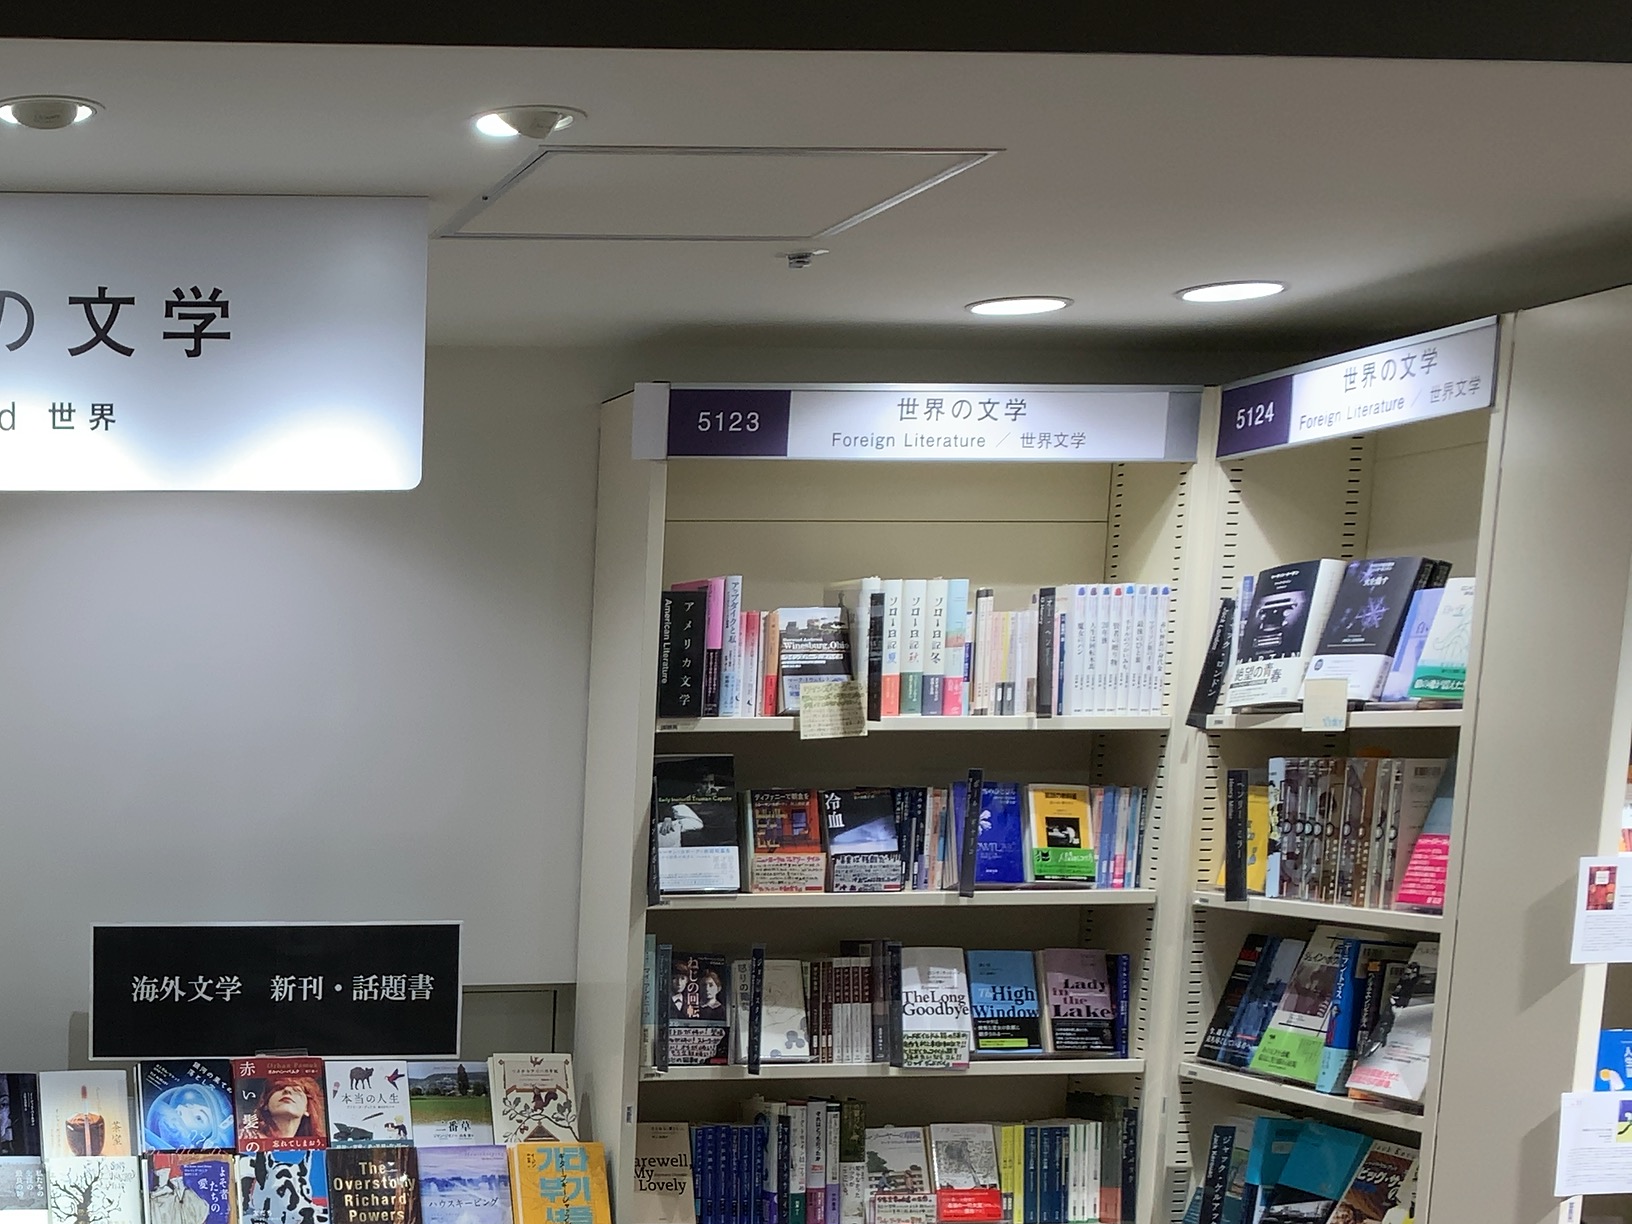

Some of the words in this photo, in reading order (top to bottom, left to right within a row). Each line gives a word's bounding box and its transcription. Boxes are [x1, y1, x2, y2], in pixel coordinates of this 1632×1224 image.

[1343, 348, 1440, 392] 世界の文学
[896, 397, 1029, 422] 世界の文学
[1299, 407, 1343, 430] Foreign
[1347, 395, 1406, 420] Literature
[1430, 375, 1482, 404] 世界文学
[48, 402, 118, 432] 世界
[697, 411, 760, 432] 5123
[1236, 402, 1276, 430] 5124
[831, 431, 897, 450] Foreign
[904, 431, 986, 447] Literature
[1020, 432, 1087, 449] 世界文学
[663, 598, 673, 641] American
[727, 581, 740, 644] アップダイクと私
[661, 642, 672, 685] Literature
[679, 601, 695, 707] アメリカ文学
[930, 651, 942, 665] 冬
[1233, 661, 1283, 684] 絶望の青春
[824, 792, 846, 829] 冷血
[131, 974, 243, 1001] 海外文学
[270, 973, 436, 1002] 新刊・話題書
[686, 957, 701, 1019] ねじの回転
[991, 985, 1037, 1006] High
[1063, 978, 1108, 994] Lady
[902, 990, 929, 1003] The
[930, 990, 967, 1005] Long
[902, 1002, 970, 1020] Goodbye
[972, 1004, 1040, 1018] Window
[1052, 1004, 1112, 1019] Lake
[238, 1061, 261, 1153] 赤い髪の
[340, 1091, 401, 1105] 本当の人生
[358, 1160, 387, 1176] The
[196, 1177, 209, 1191] 愛
[217, 1165, 229, 1201] よそ者
[638, 1177, 687, 1196] Lovely
[209, 1180, 220, 1214] たちの
[343, 1191, 408, 1207] Richard
[427, 1197, 500, 1209] ハウスキーピング
[348, 1208, 406, 1224] Powers
